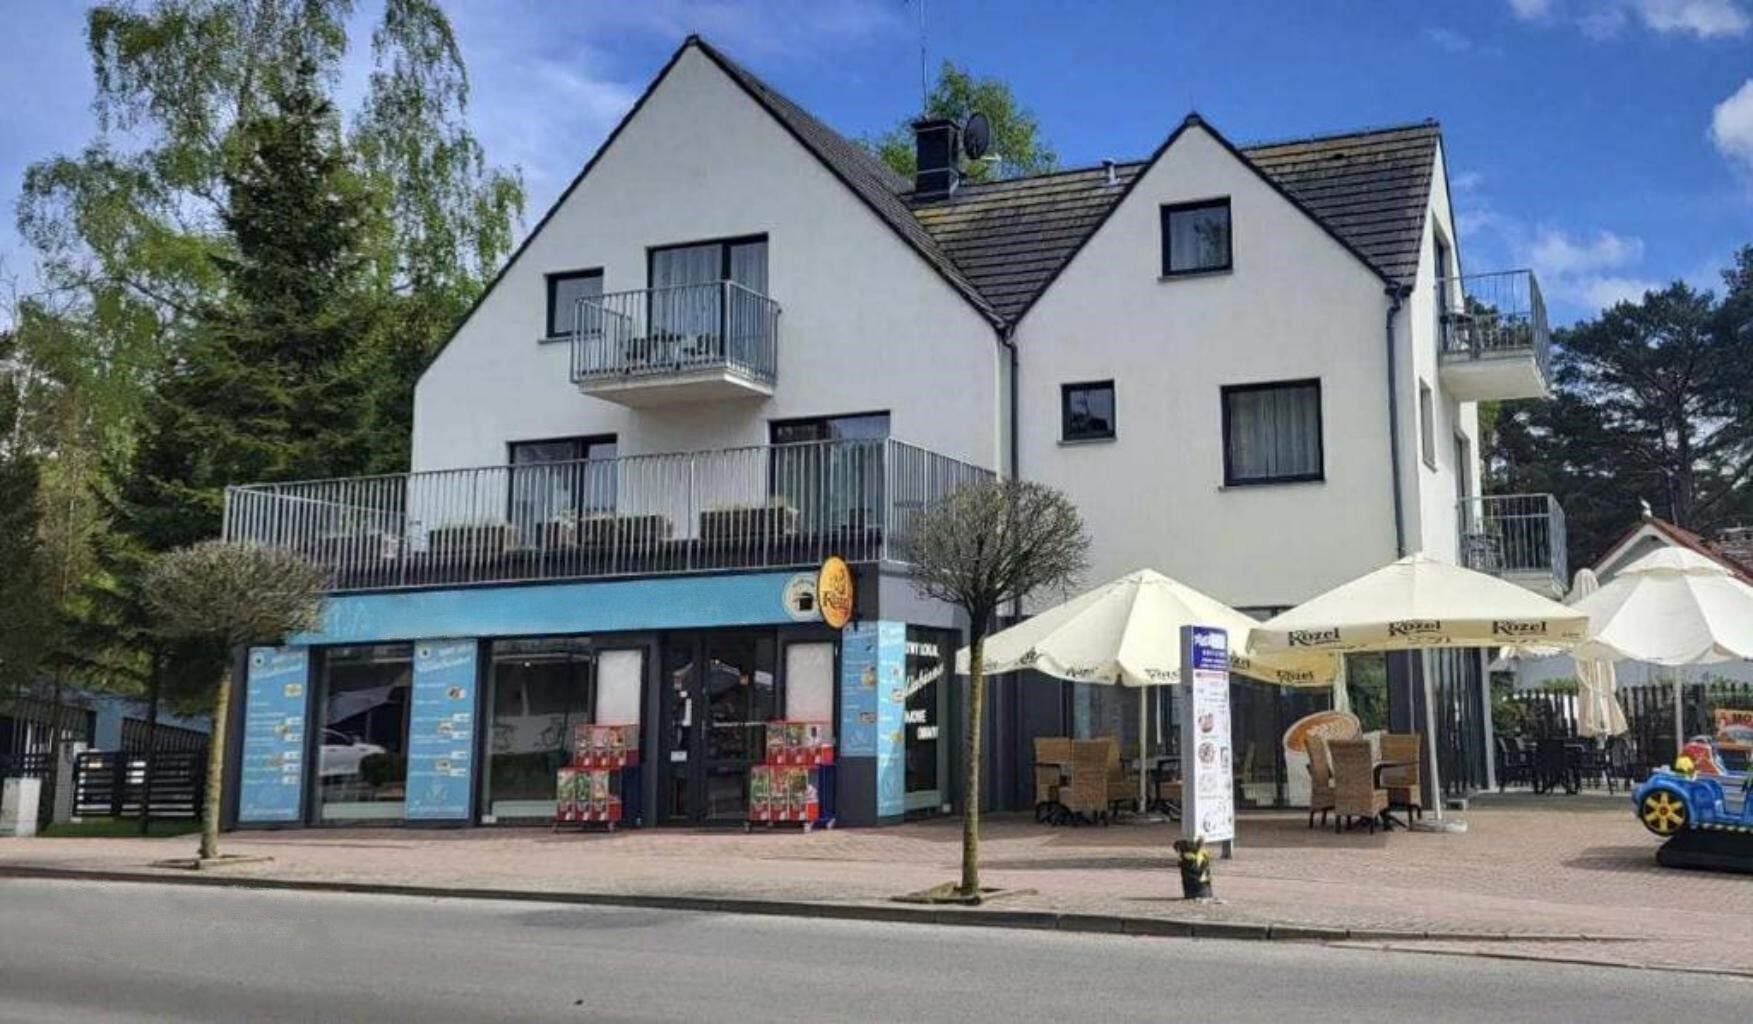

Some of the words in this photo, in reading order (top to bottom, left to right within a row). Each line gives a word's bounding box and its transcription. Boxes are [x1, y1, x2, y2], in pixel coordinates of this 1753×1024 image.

[1388, 620, 1441, 637] Kozel
[1492, 620, 1546, 636] Kozel
[1288, 627, 1341, 647] Kozel
